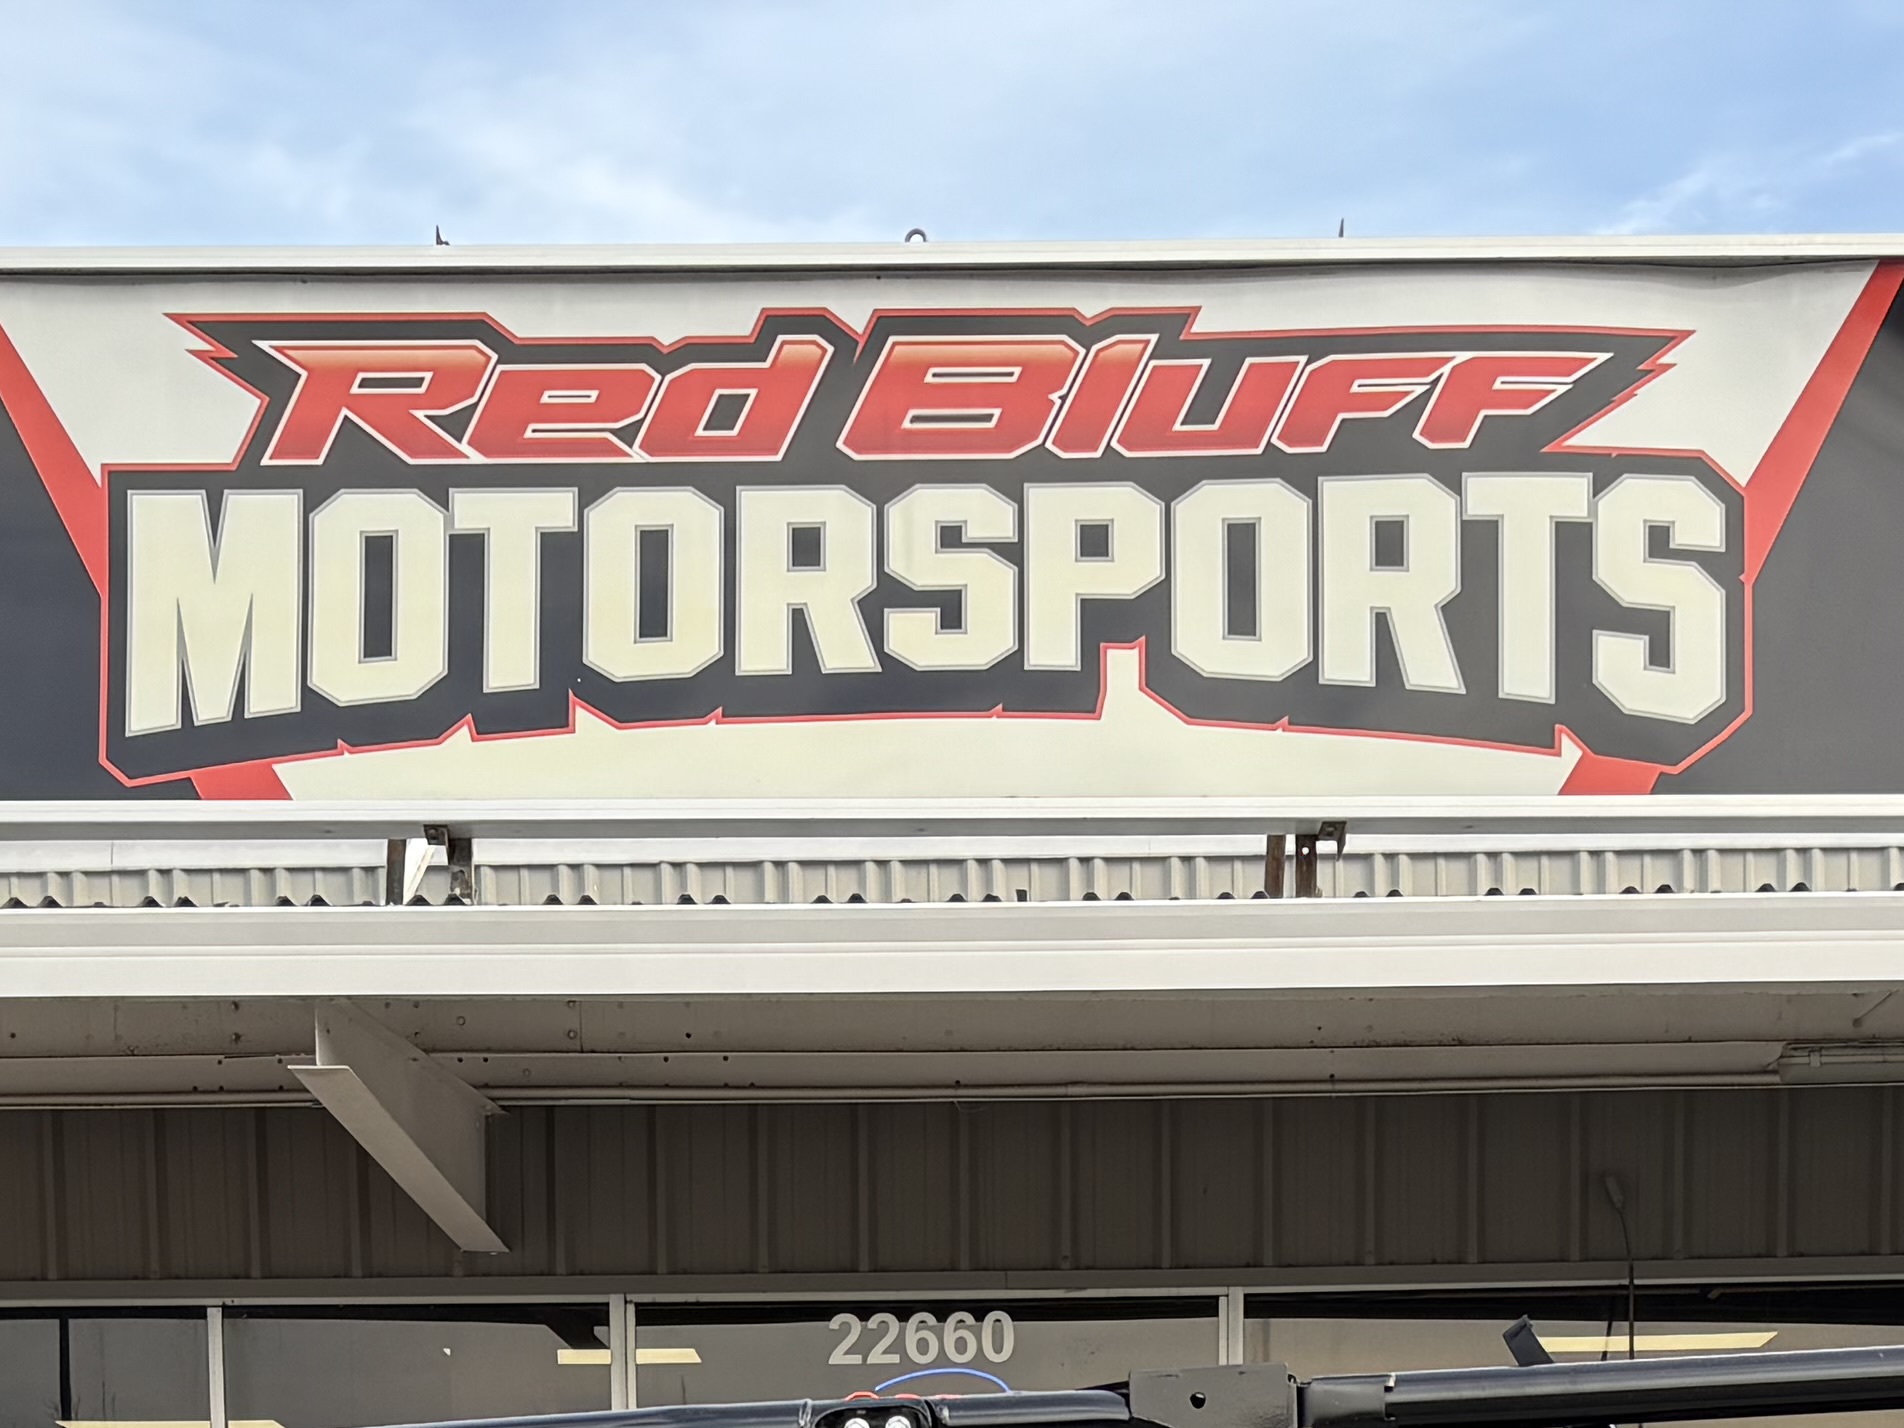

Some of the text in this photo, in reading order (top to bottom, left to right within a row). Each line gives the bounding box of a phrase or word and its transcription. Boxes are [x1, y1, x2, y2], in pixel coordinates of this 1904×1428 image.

[251, 336, 794, 466] Red
[124, 472, 1728, 740] MOTORSPORTS
[828, 1311, 1015, 1365] 22660
